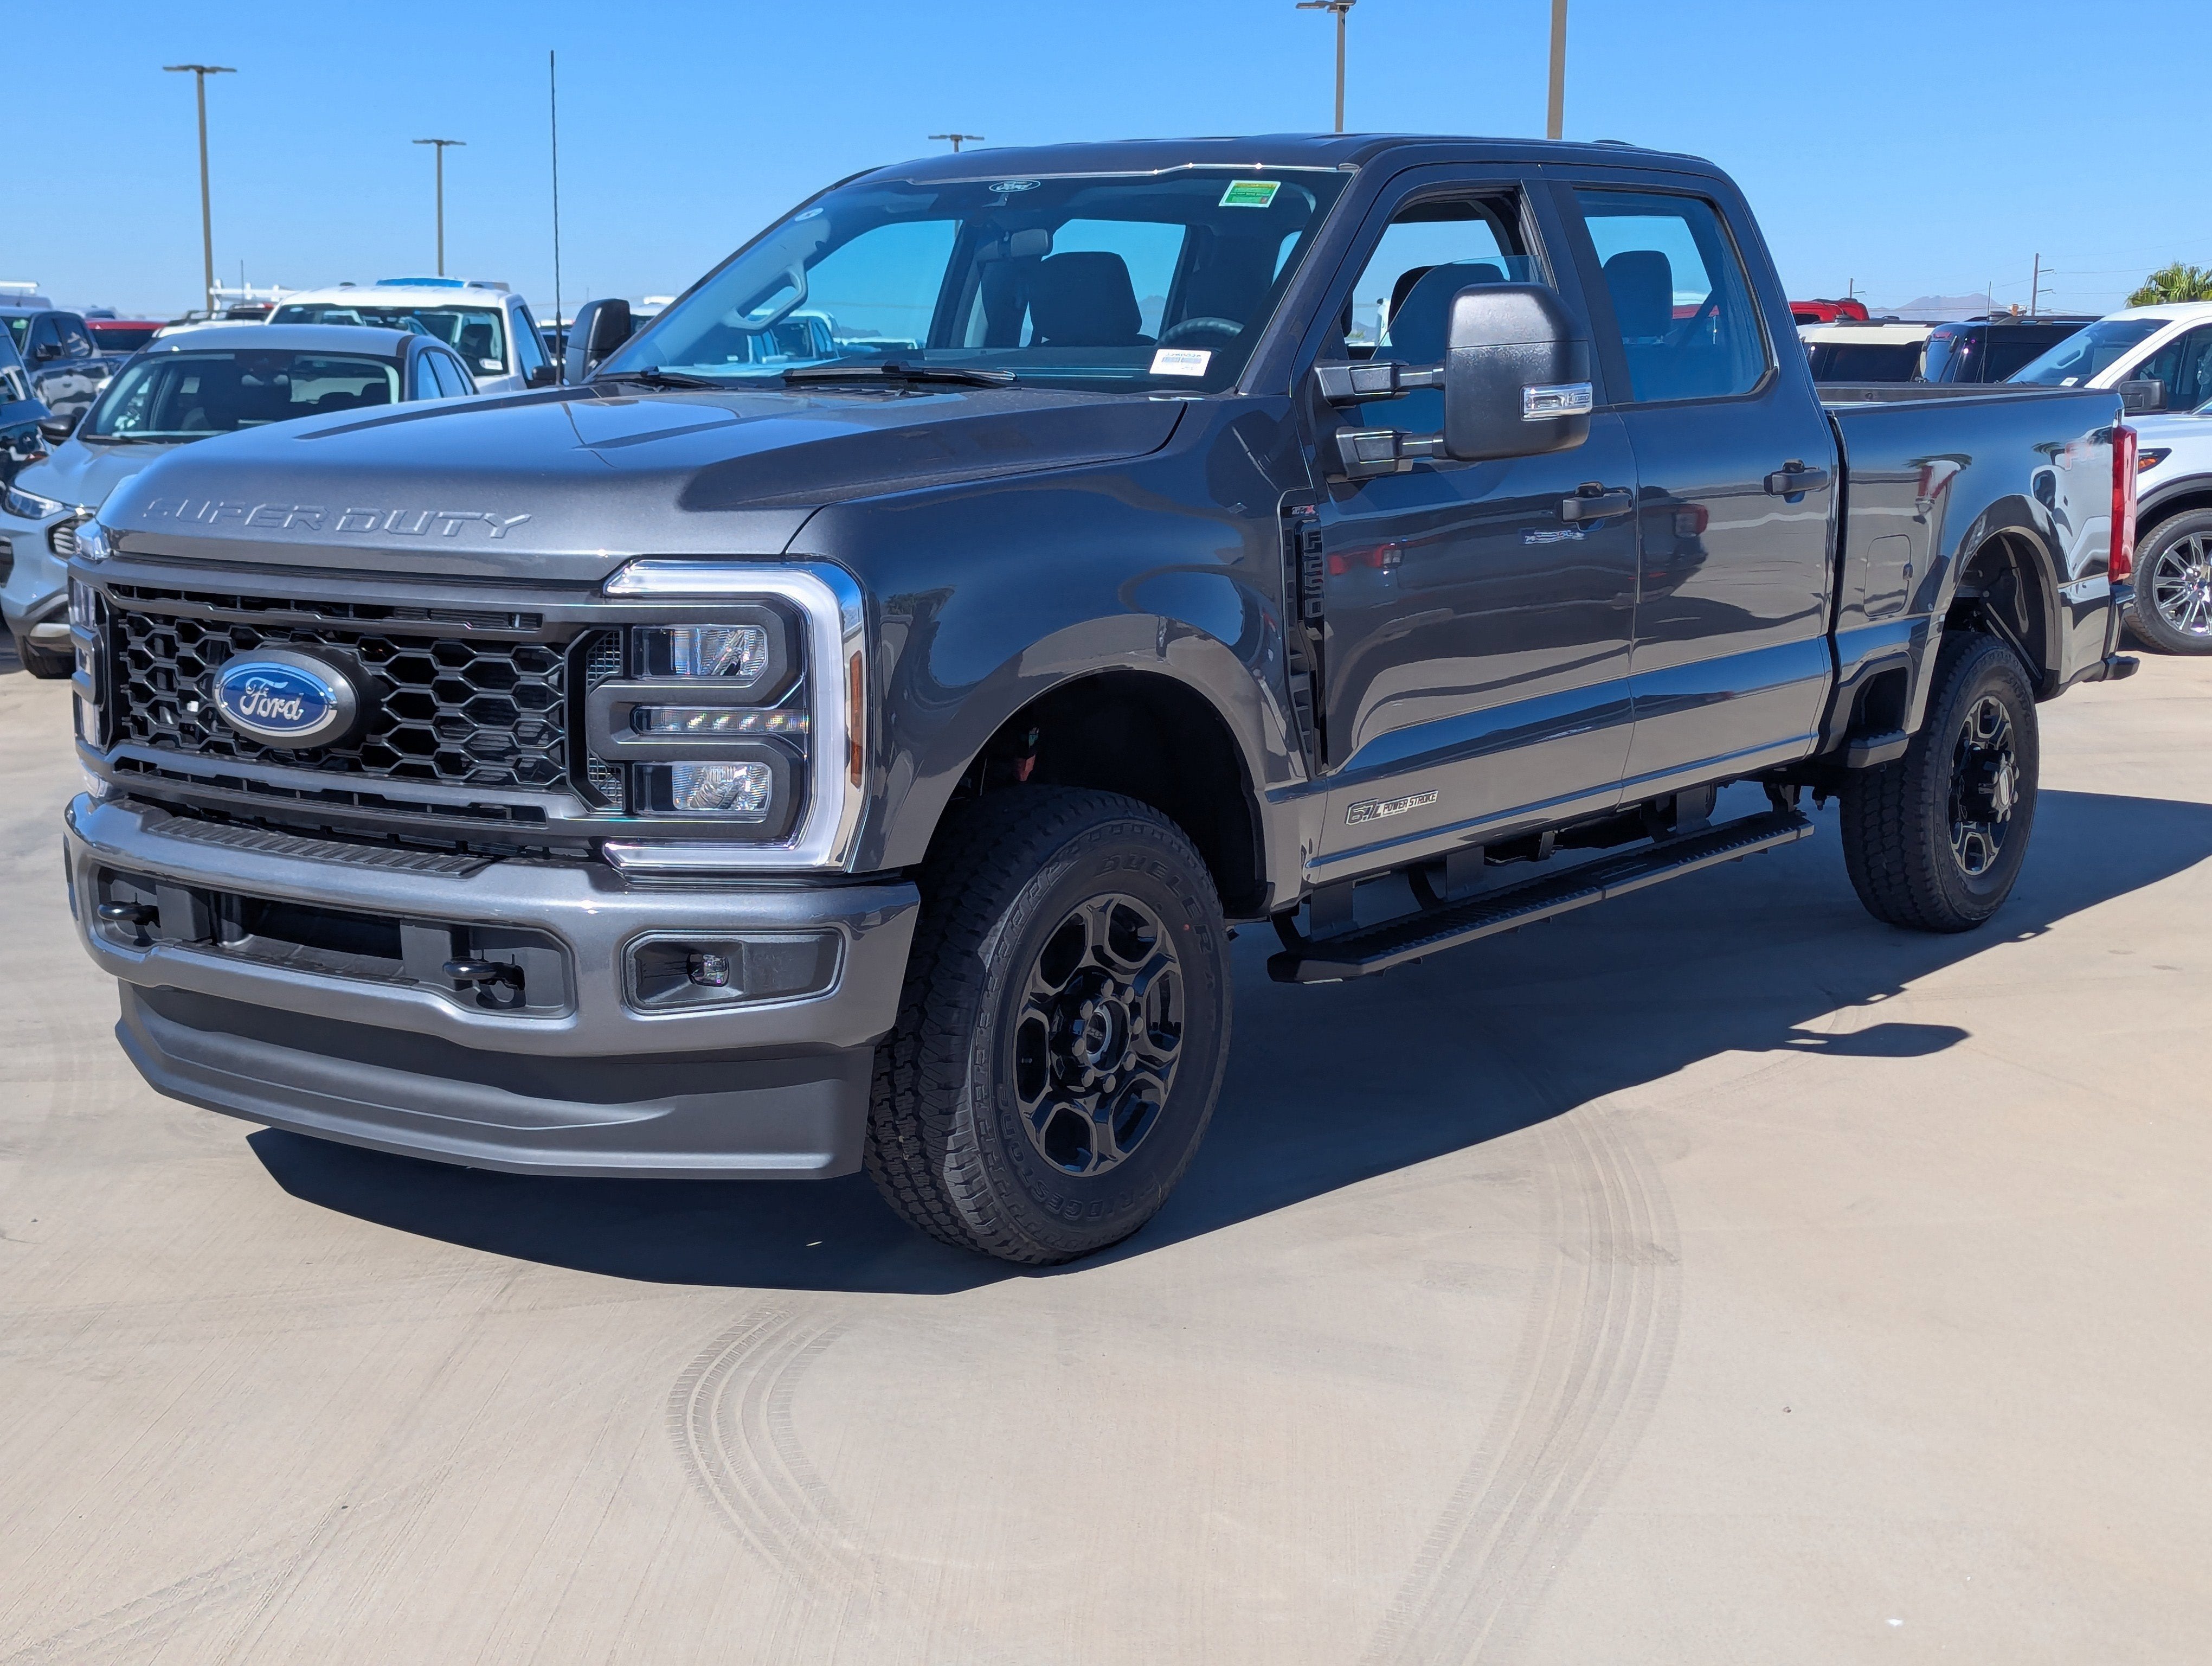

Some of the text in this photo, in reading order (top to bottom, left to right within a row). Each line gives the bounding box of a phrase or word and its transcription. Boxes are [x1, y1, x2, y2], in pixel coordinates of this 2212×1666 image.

[143, 498, 532, 540] SUPER DUTY
[240, 676, 305, 721] Ford
[1347, 800, 1382, 824] 6.7L
[1382, 799, 1409, 813] POWER
[1094, 854, 1213, 956] DUELER
